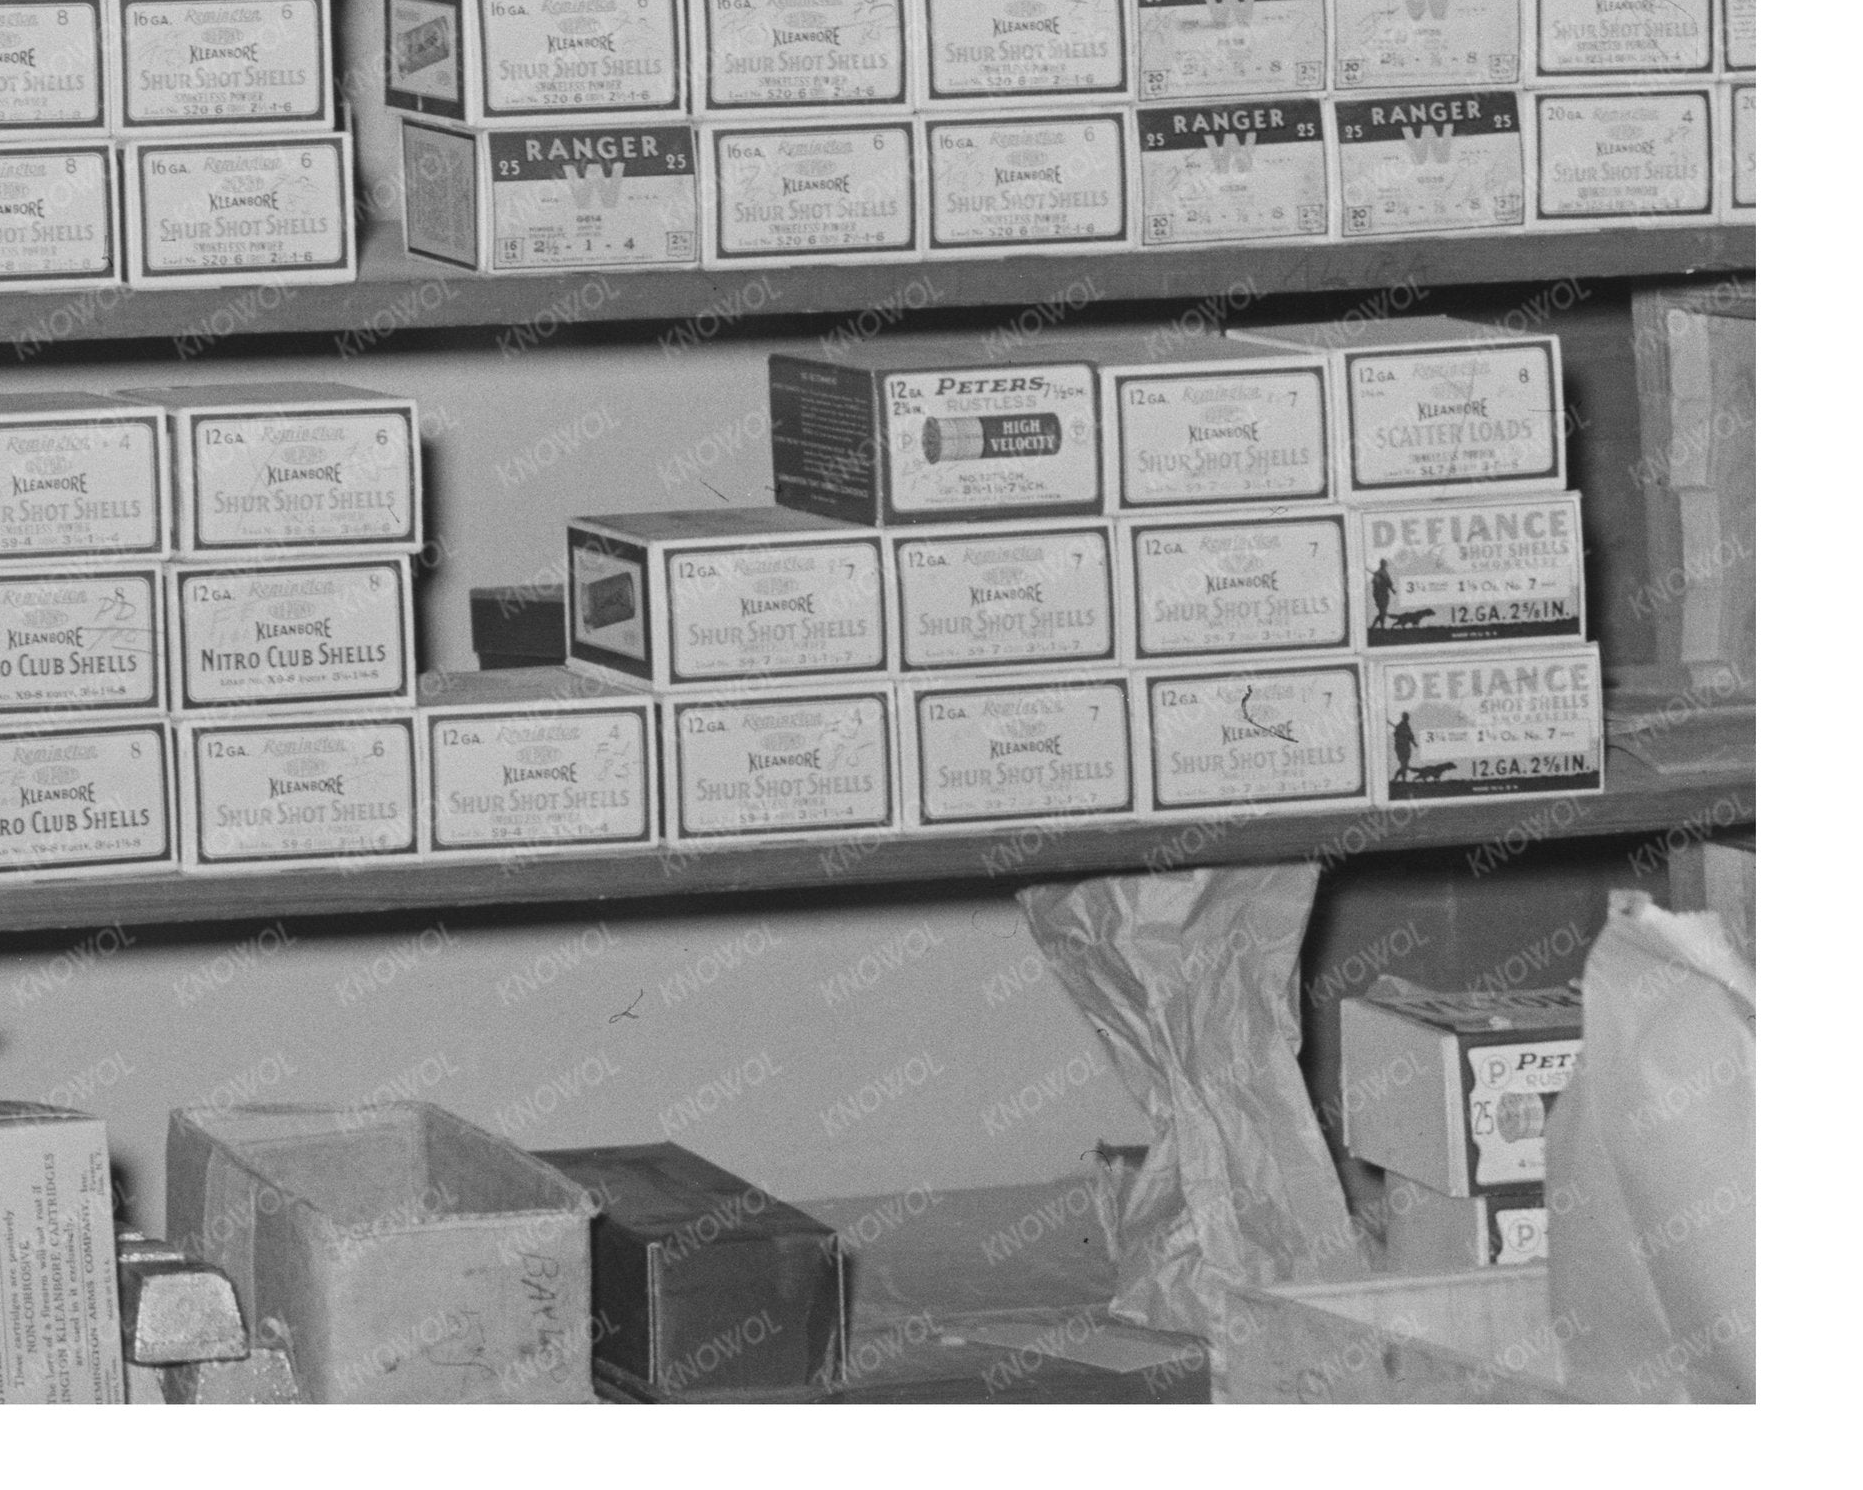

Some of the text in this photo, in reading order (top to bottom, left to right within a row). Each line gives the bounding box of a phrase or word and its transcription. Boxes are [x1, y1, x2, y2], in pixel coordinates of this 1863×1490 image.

[524, 134, 660, 160] RANGER
[935, 376, 1045, 395] PETERS
[1003, 419, 1041, 435] HIGH
[990, 435, 1056, 451] VELOCITY
[1371, 509, 1569, 549] DEFIANCE
